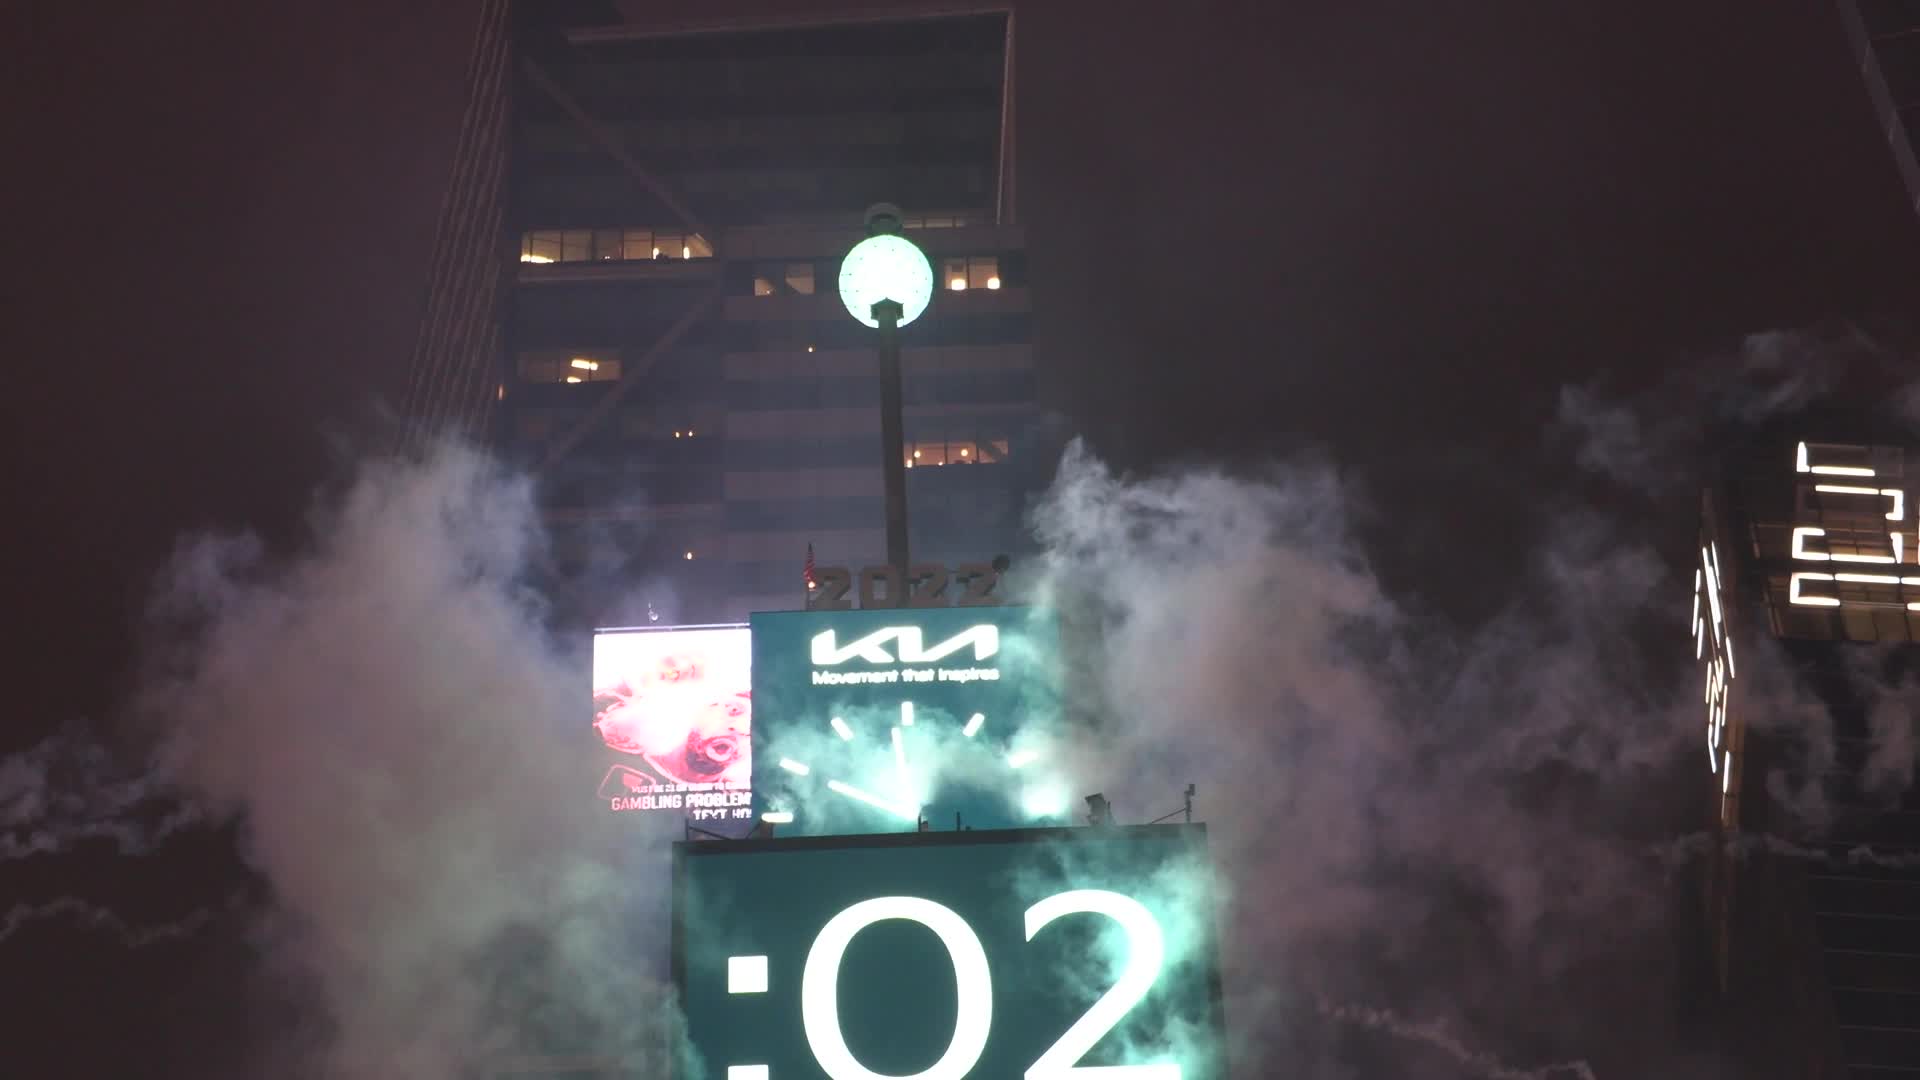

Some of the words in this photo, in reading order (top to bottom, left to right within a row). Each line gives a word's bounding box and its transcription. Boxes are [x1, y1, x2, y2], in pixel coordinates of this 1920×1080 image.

[814, 563, 1000, 610] 2022
[811, 624, 999, 665] KIA
[812, 670, 899, 685] Movement
[901, 669, 935, 683] that
[611, 793, 682, 811] GAMBLING
